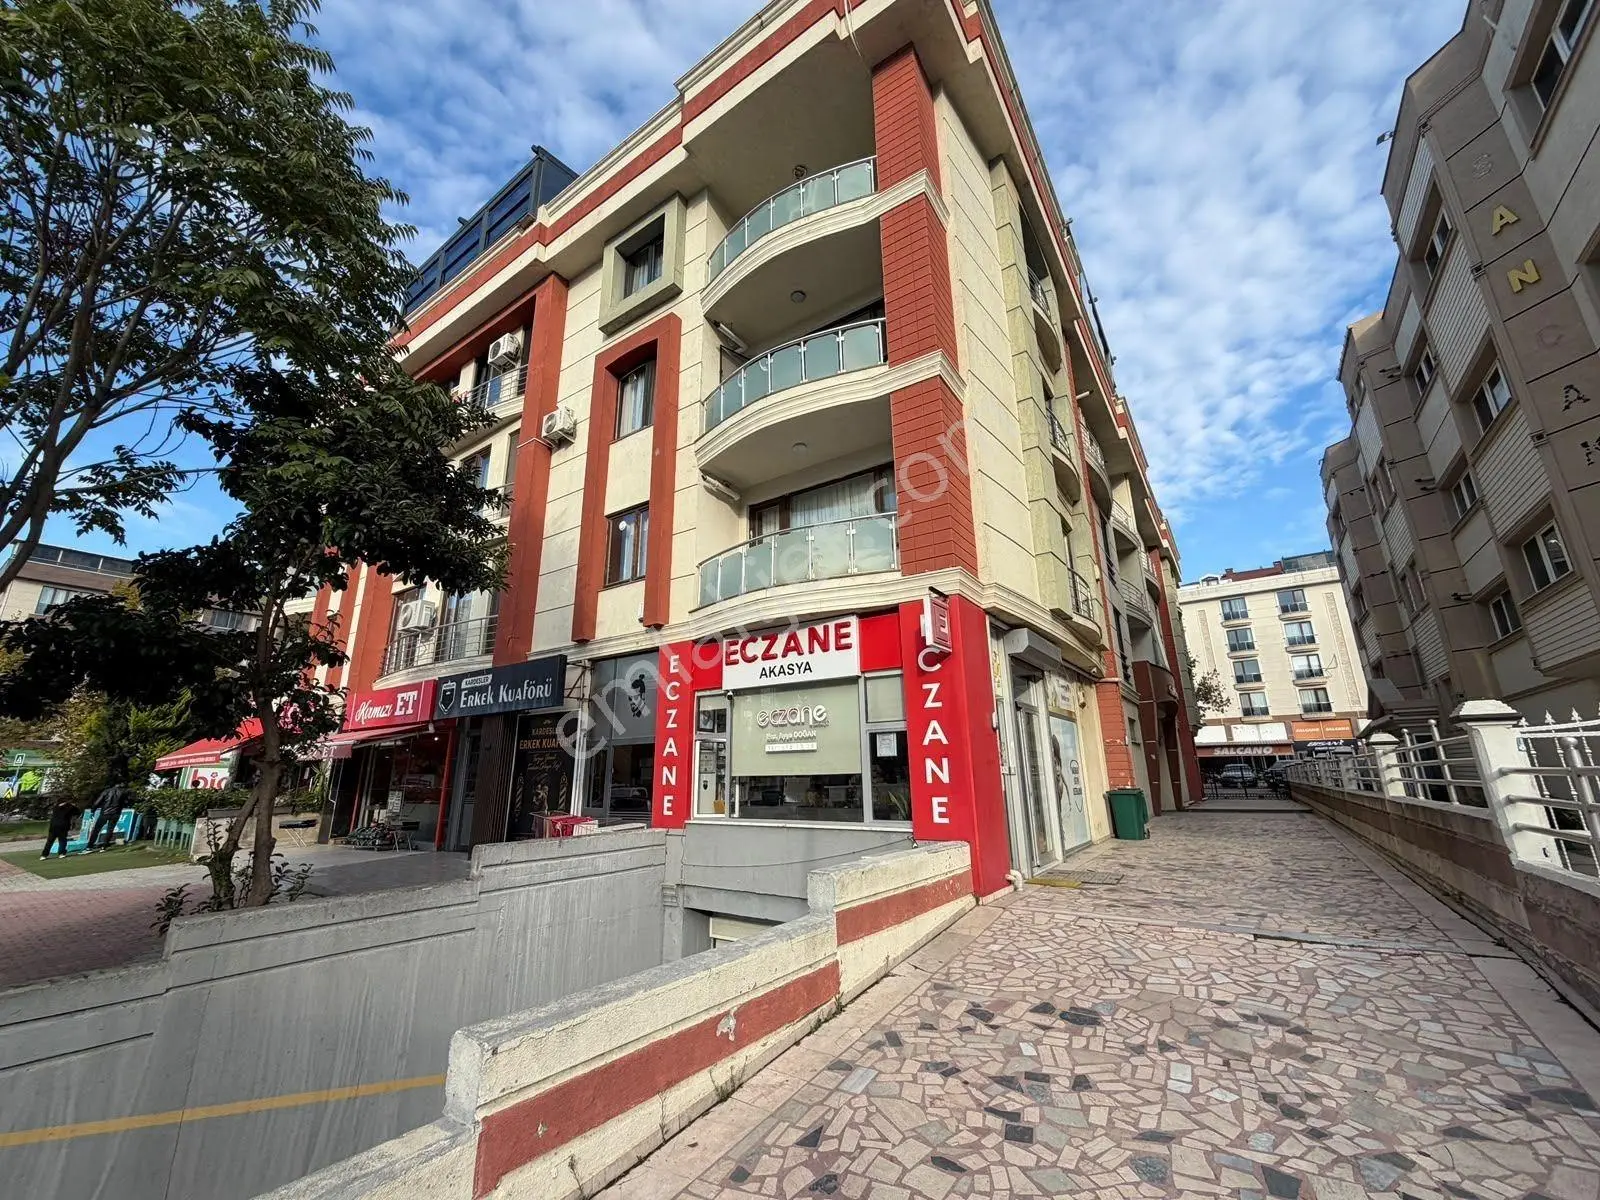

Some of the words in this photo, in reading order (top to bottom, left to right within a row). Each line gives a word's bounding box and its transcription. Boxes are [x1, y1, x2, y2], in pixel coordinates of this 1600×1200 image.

[725, 621, 852, 666] ECZANE
[759, 661, 813, 679] AKASYA
[394, 690, 418, 716] ET
[757, 704, 827, 728] eczane
[661, 655, 680, 816] ECZANE
[917, 647, 950, 824] CZANE
[1213, 746, 1273, 756] SALCANO
